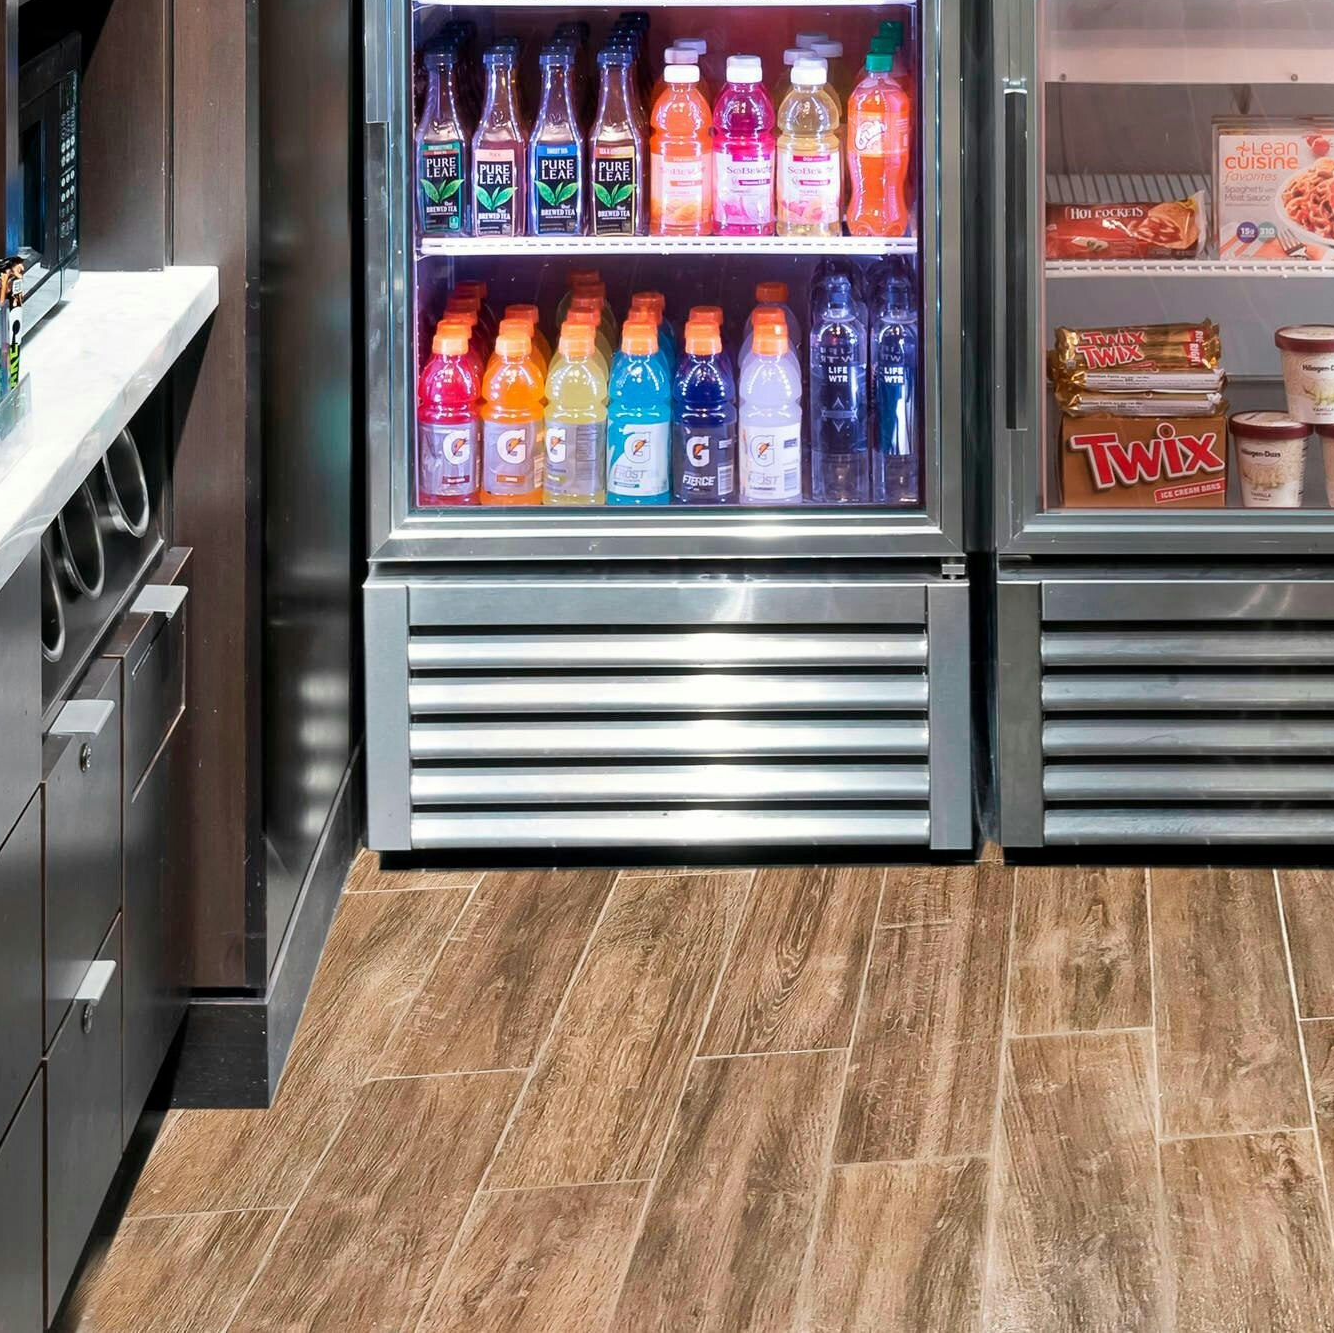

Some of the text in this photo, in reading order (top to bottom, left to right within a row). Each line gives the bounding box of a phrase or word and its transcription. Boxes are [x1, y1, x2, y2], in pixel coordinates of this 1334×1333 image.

[1252, 140, 1299, 156] Lean
[426, 157, 457, 168] PURE
[541, 159, 574, 170] PURE
[598, 161, 630, 172] PURE
[479, 164, 510, 175] PURE
[1222, 170, 1278, 186] favorites
[1224, 185, 1264, 196] Spaghetti
[1224, 193, 1271, 202] Meat Sauce
[1259, 227, 1275, 235] 310
[828, 366, 848, 374] LIFE
[884, 367, 904, 375] LIFE
[828, 375, 848, 383] WTR
[884, 375, 904, 383] WTR
[443, 429, 470, 465] G
[497, 429, 526, 464] G
[545, 427, 566, 463] G
[624, 431, 651, 463] G
[750, 435, 775, 466] G
[686, 436, 710, 467] G
[682, 474, 716, 487] FIERCE
[1161, 482, 1221, 499] ICE CREAM BARS
